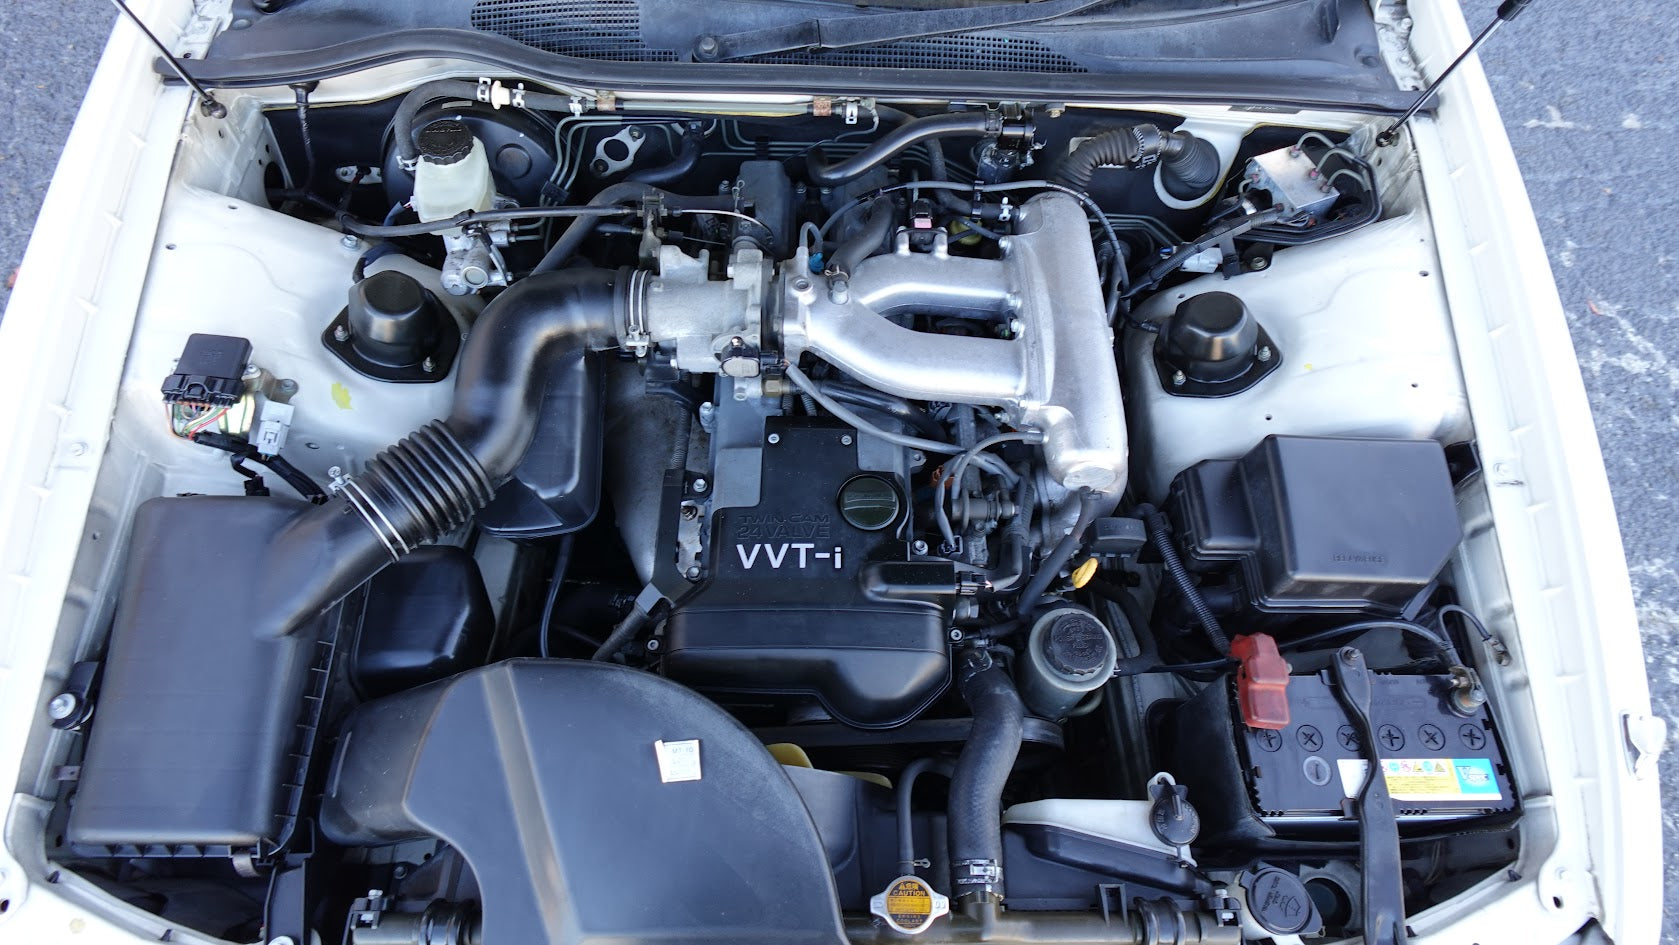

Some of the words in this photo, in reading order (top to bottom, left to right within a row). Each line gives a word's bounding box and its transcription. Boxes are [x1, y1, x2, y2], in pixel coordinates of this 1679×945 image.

[736, 526, 764, 540] 24
[766, 524, 831, 539] VALVE
[736, 543, 842, 569] VVT-i
